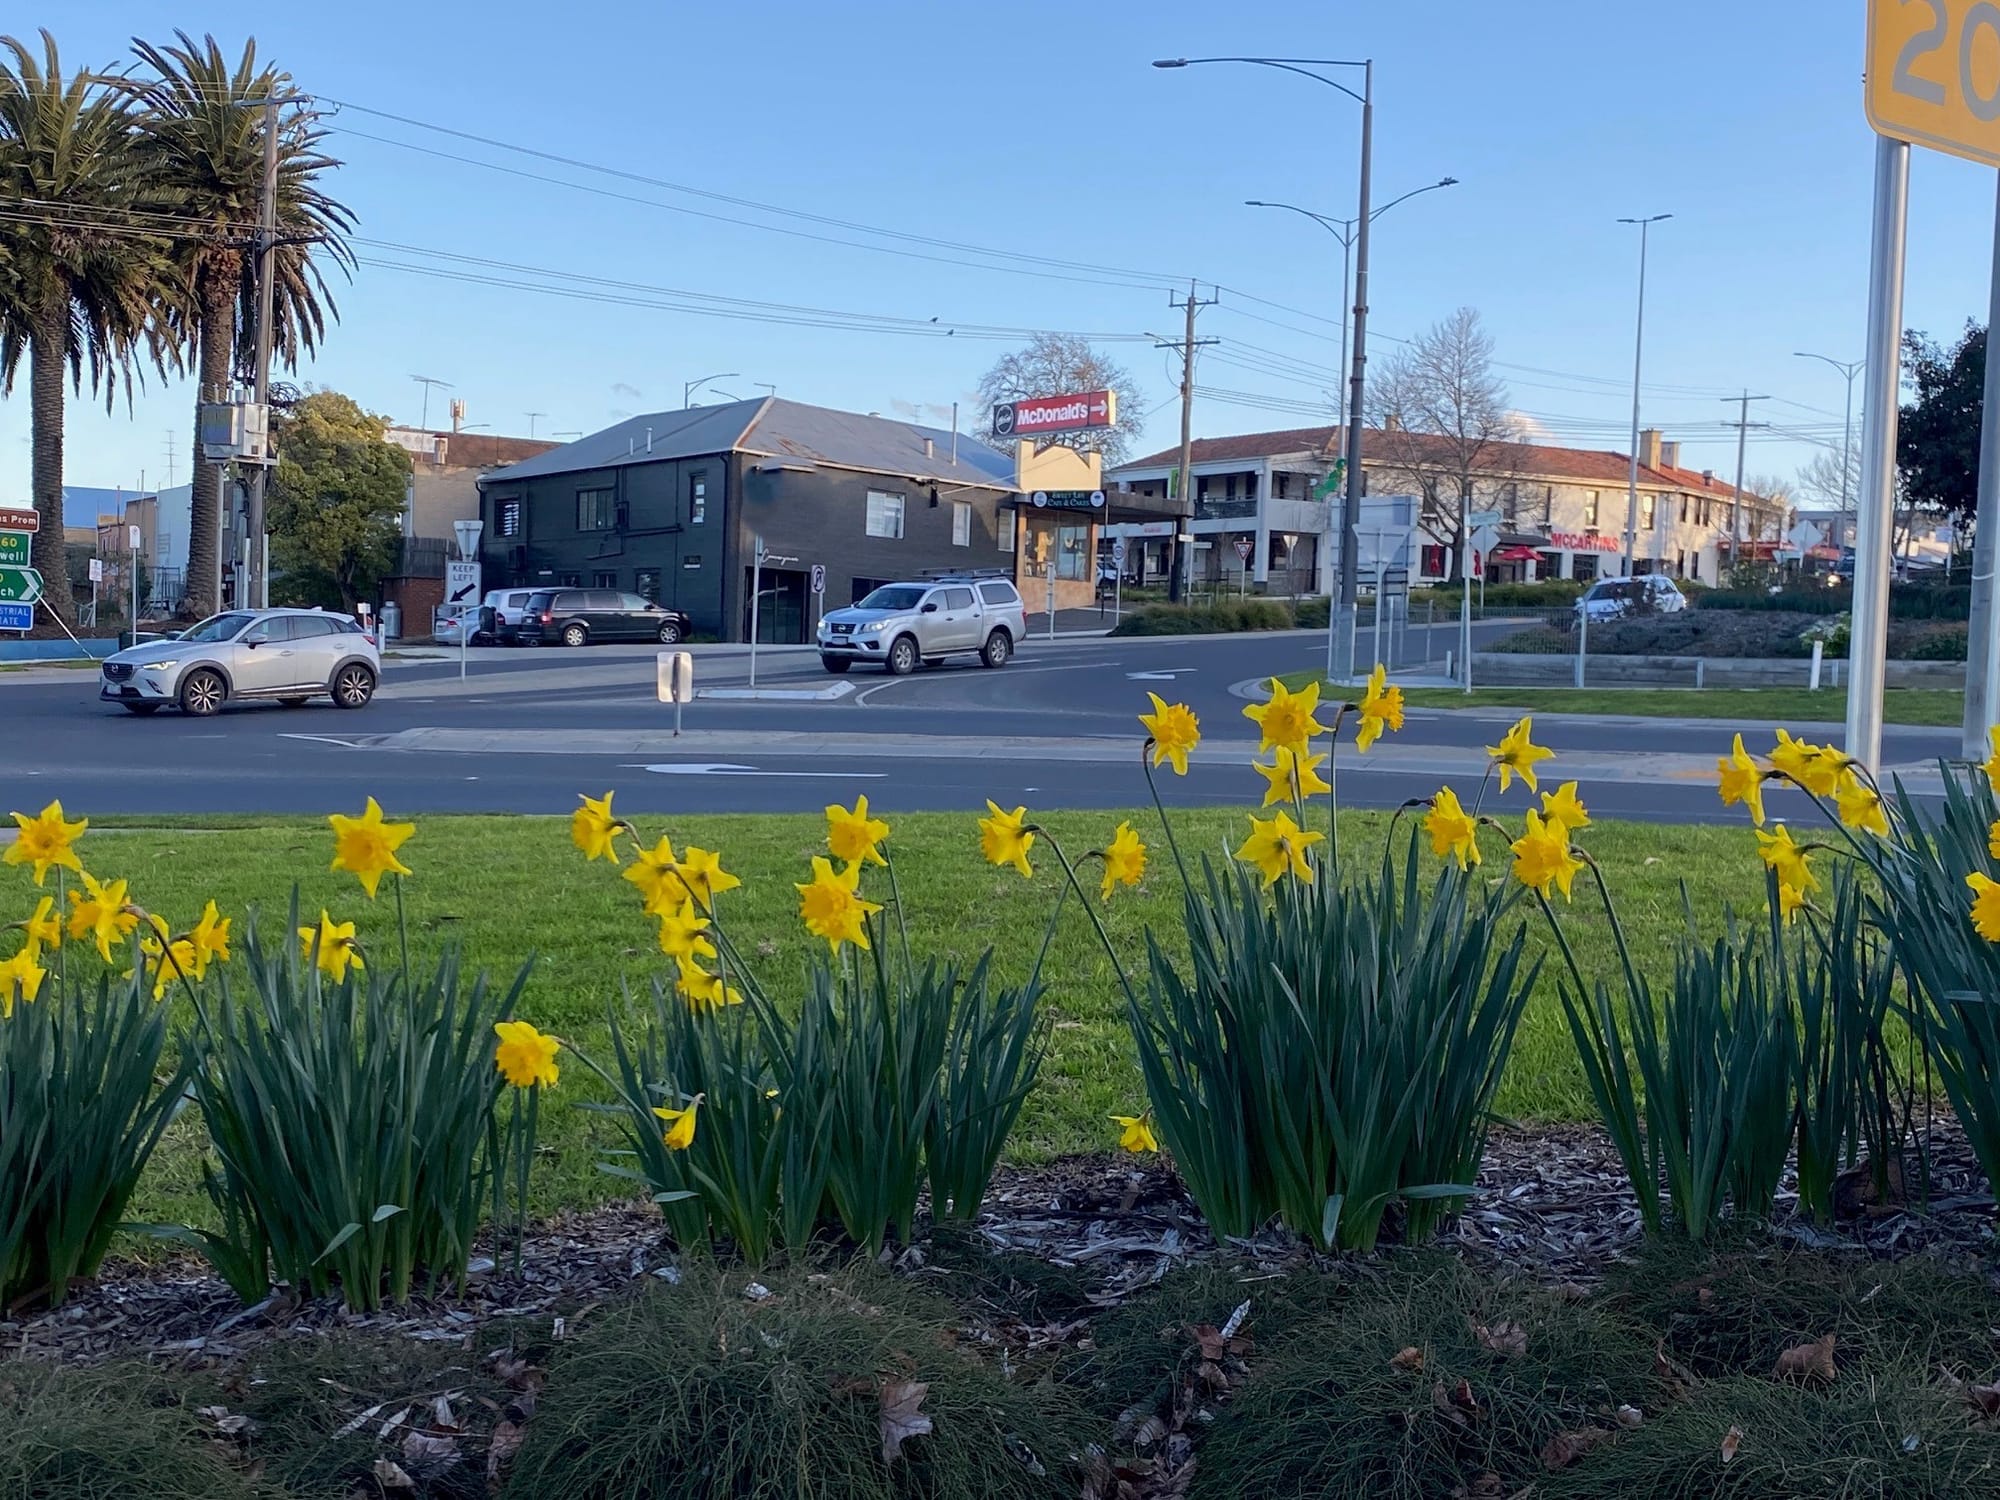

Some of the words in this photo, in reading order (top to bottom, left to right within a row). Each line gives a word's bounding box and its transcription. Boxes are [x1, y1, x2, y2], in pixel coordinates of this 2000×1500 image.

[1892, 0, 2000, 122] 20
[1017, 402, 1089, 425] McDonald's
[11, 515, 36, 524] Prom
[453, 565, 475, 573] KEEP
